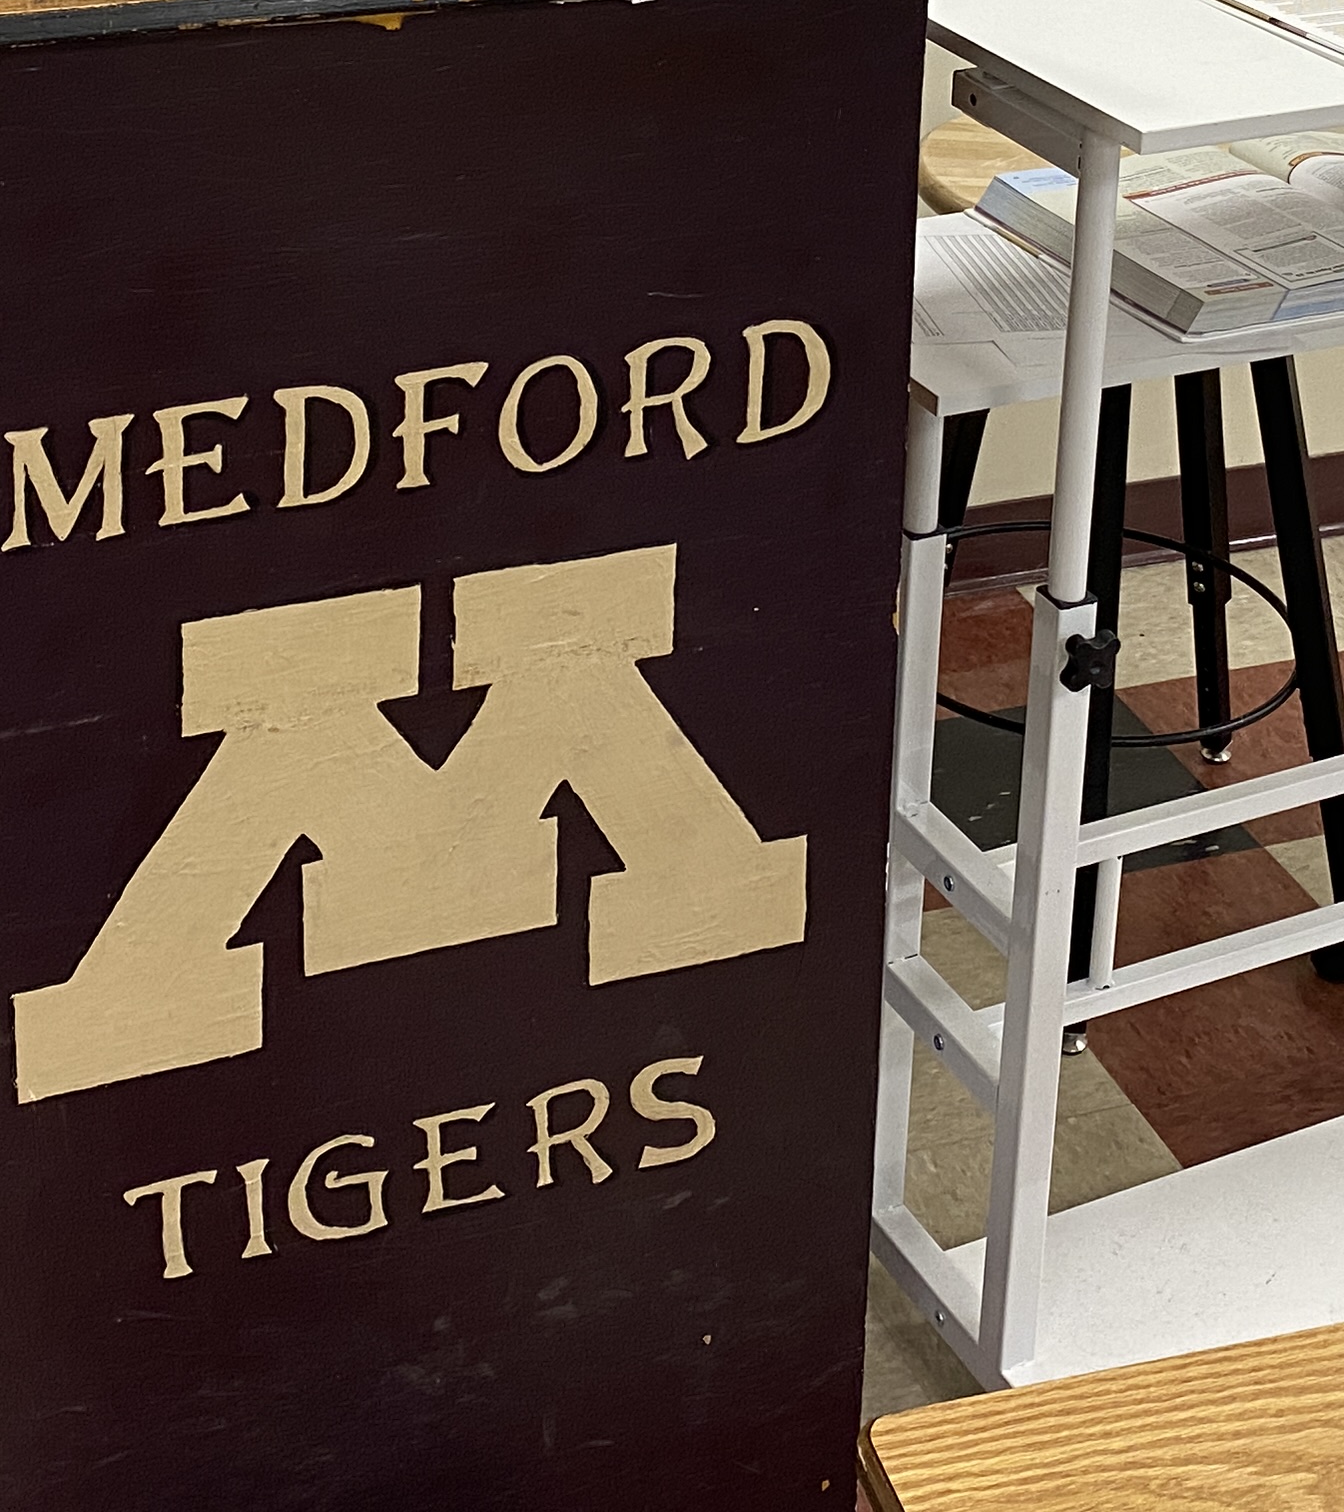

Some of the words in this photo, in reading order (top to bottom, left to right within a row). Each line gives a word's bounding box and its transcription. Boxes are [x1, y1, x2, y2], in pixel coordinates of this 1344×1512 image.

[1, 319, 831, 551] MEDFORD
[12, 543, 807, 1104] M
[124, 1054, 715, 1278] TIGERS
